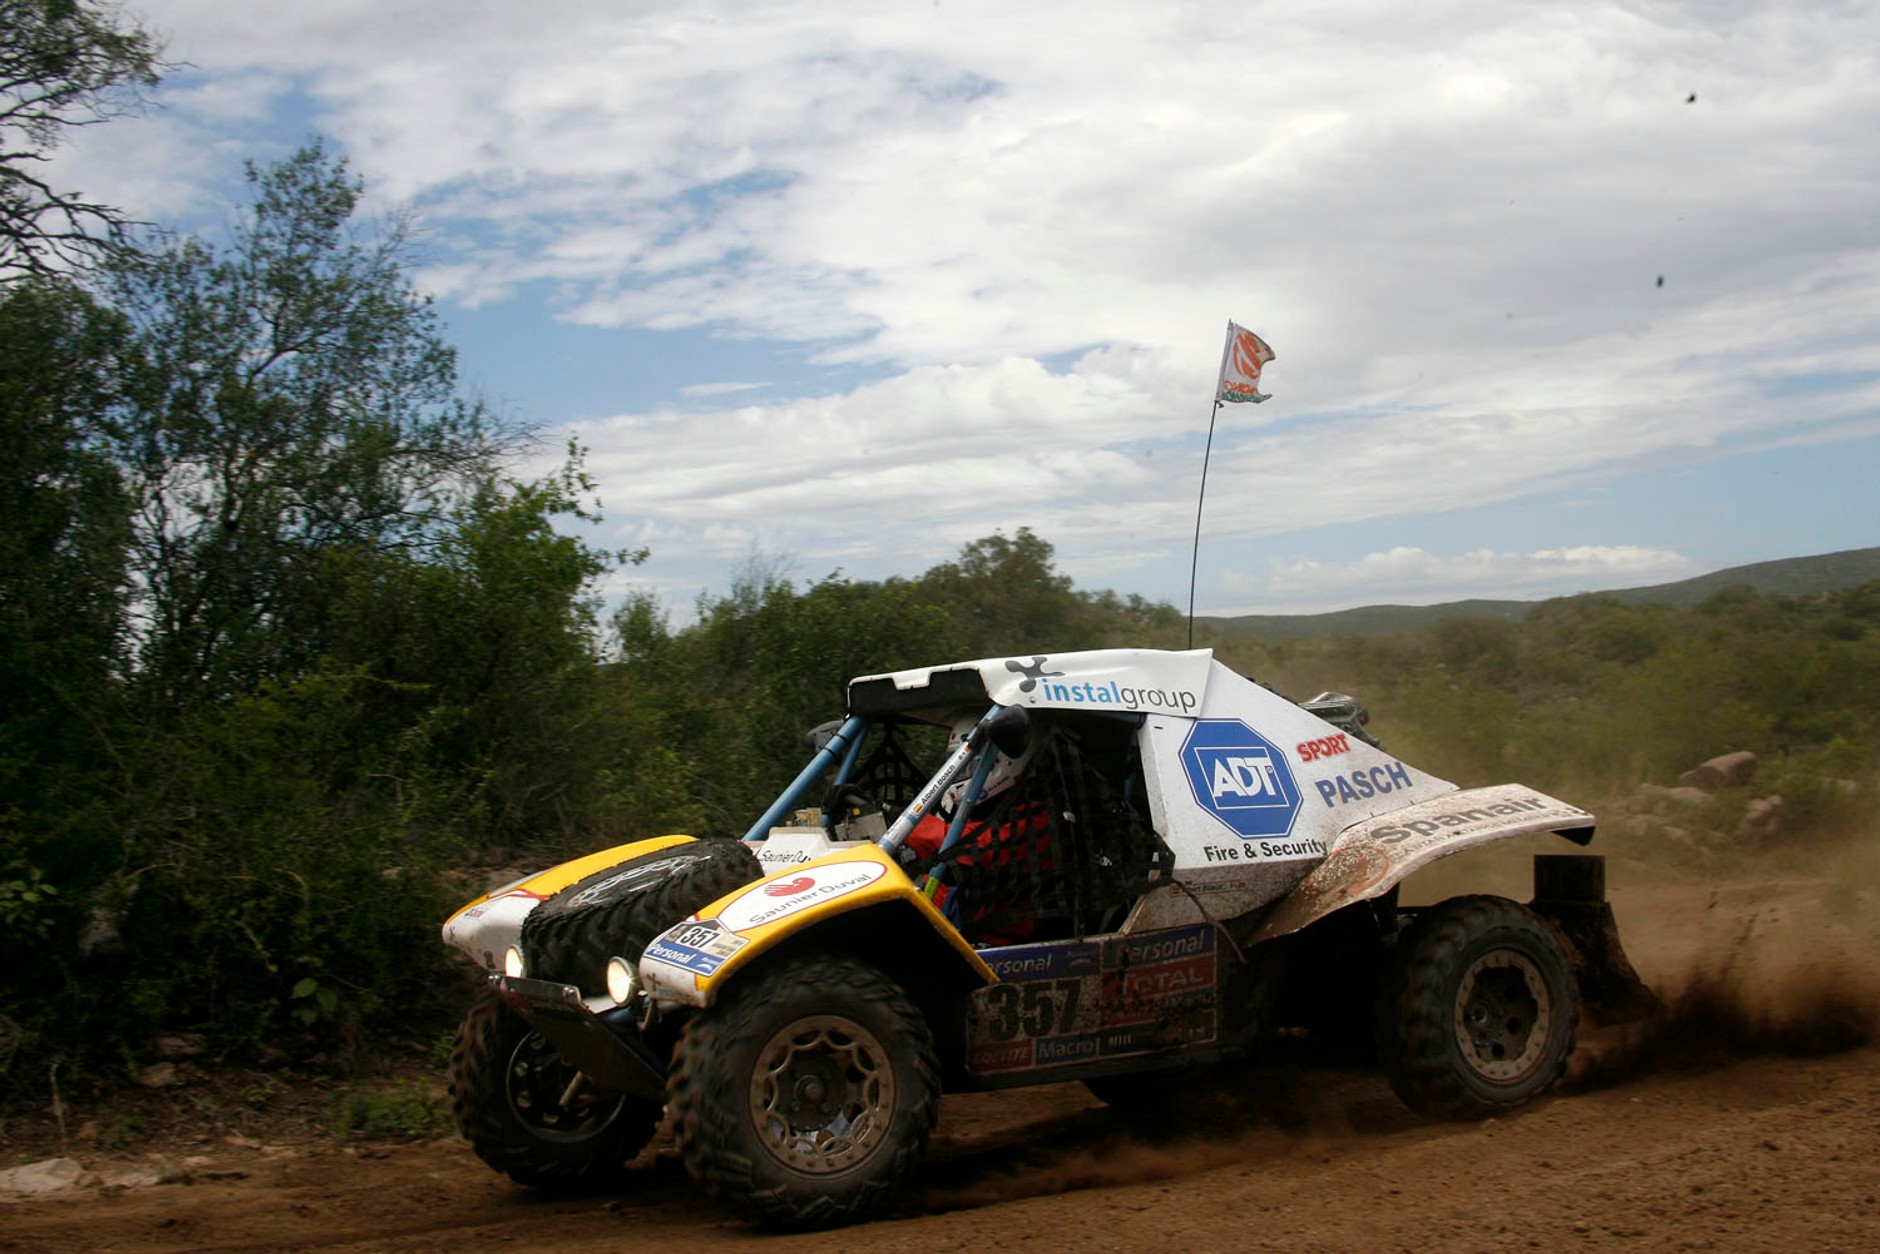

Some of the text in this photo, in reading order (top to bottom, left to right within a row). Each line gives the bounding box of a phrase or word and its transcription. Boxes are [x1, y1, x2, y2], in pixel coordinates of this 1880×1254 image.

[1041, 677, 1196, 714] instalgroup
[1296, 733, 1351, 762] SPORT
[1213, 756, 1277, 798] ADT
[1314, 761, 1414, 809] PASCH
[1370, 797, 1548, 844] Spanair
[1203, 838, 1328, 861] Fire & Security
[750, 873, 873, 924] Saunier Duval
[645, 942, 697, 964] Personal
[680, 927, 721, 948] 357
[986, 979, 1082, 1041] 357
[1039, 1038, 1094, 1059] Macro
